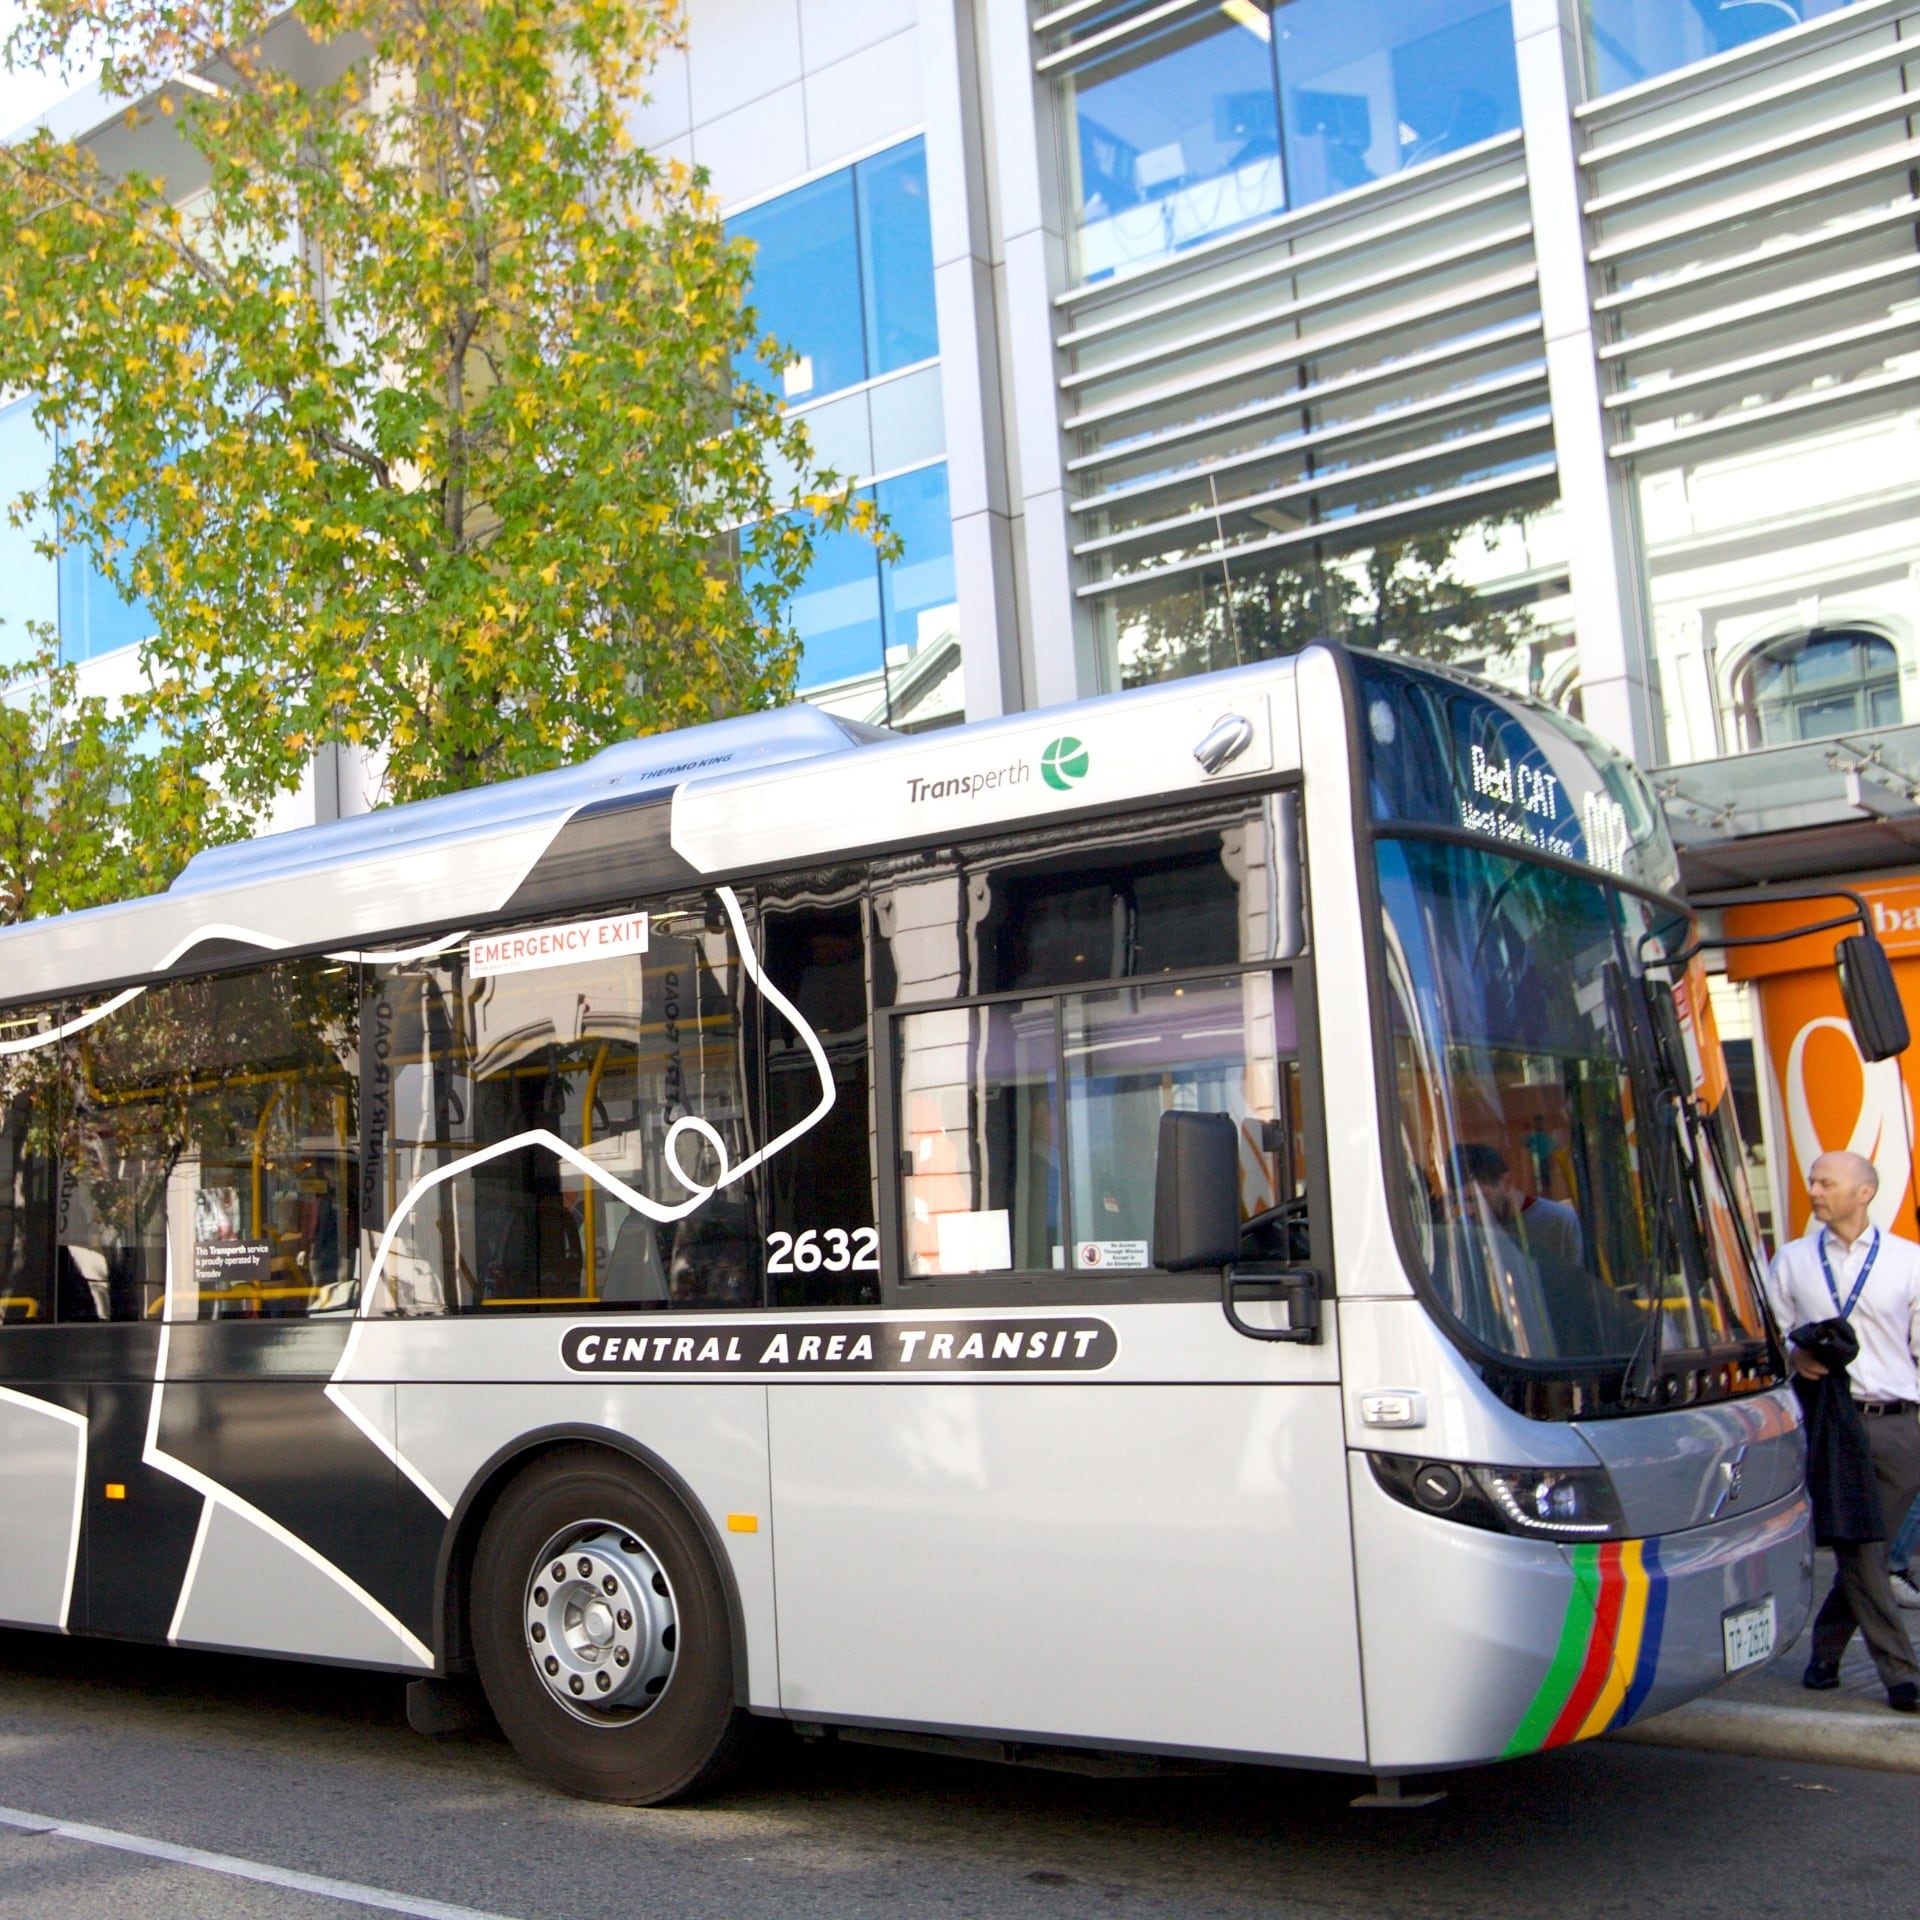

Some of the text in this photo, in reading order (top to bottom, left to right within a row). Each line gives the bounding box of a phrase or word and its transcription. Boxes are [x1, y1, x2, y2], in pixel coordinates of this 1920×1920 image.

[640, 753, 734, 780] THERMO KING
[906, 758, 1029, 803] Transperth
[1471, 744, 1557, 820] Red CAT
[1873, 901, 1920, 933] ba
[474, 920, 643, 964] EMERGENCY EXIT
[195, 1245, 269, 1256] This Transperth service
[201, 1256, 224, 1267] proudly
[224, 1255, 251, 1267] operated
[252, 1255, 260, 1265] by
[766, 1226, 880, 1273] 2632
[576, 1330, 1098, 1364] CENTRAL AREA TRANSIT
